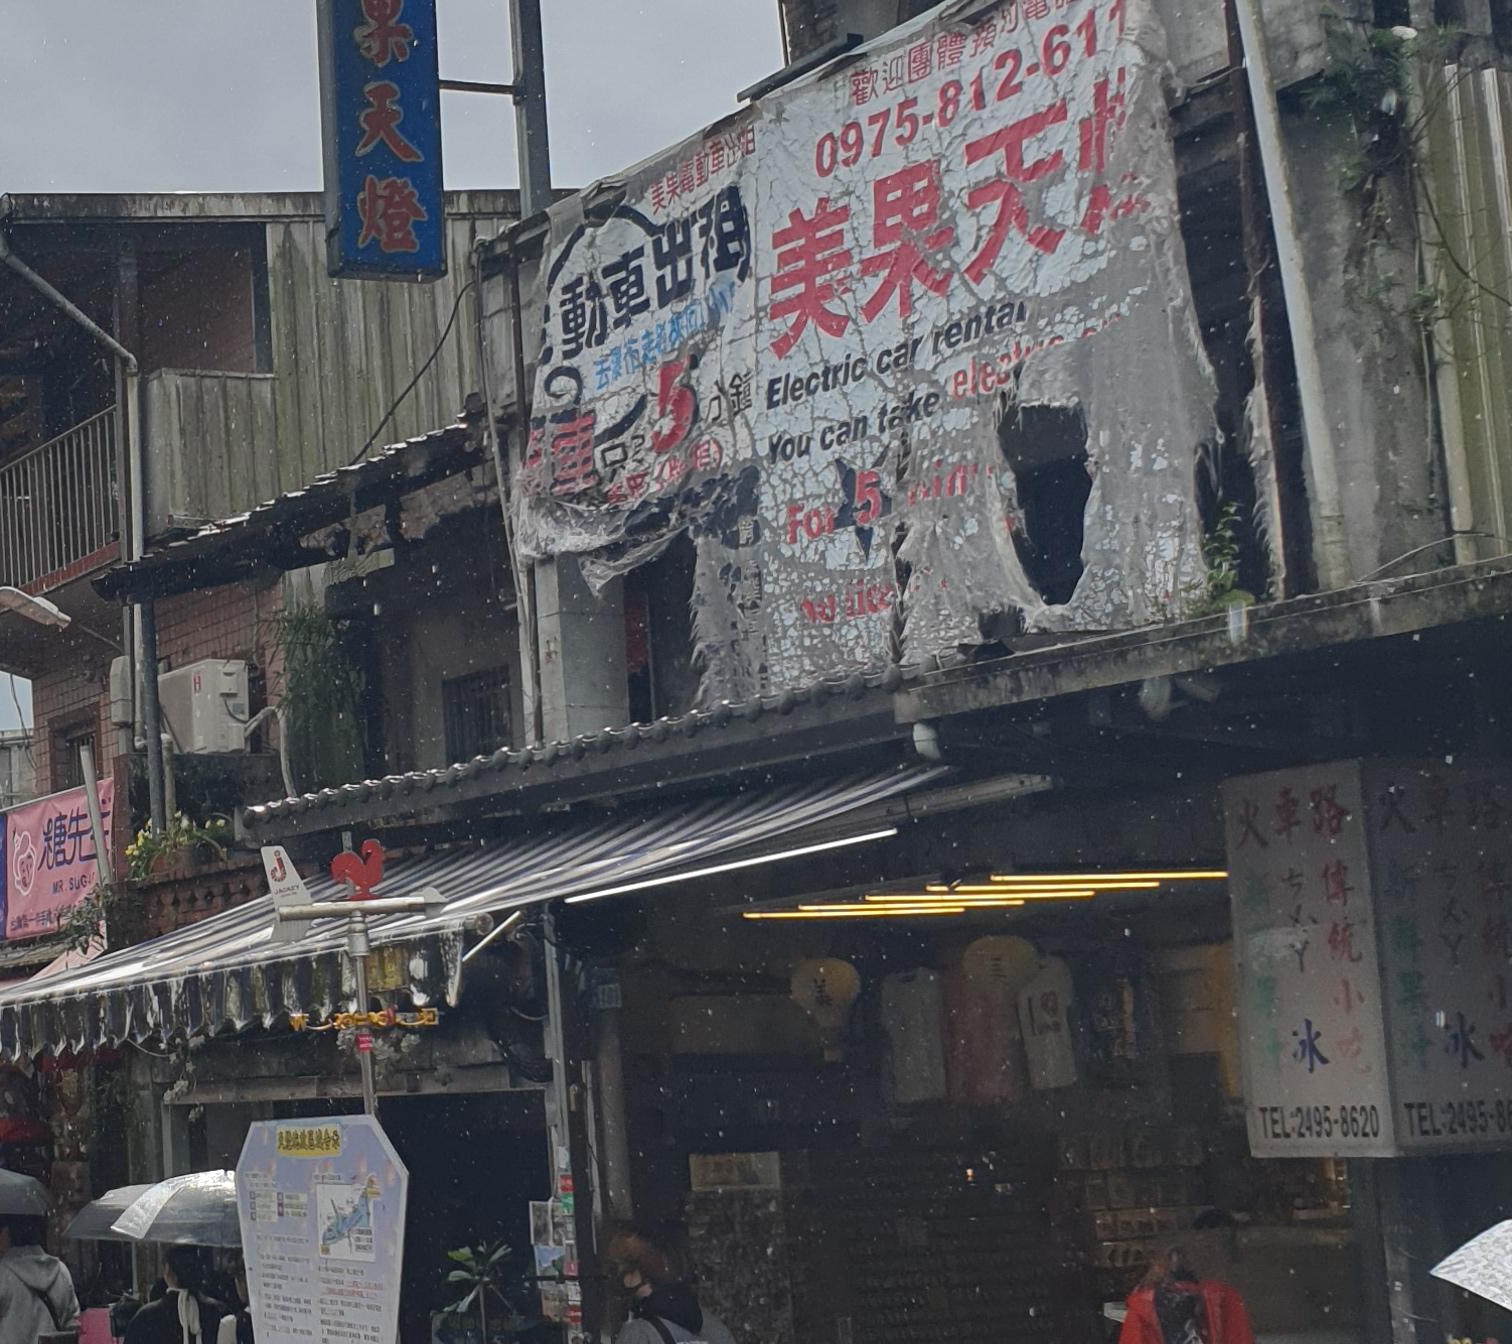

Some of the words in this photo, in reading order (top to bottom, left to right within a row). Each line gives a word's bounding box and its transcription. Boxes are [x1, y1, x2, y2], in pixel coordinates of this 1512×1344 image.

[767, 350, 867, 411] Electric
[875, 338, 919, 375] car
[767, 425, 813, 464] You
[819, 414, 868, 454] can
[854, 469, 883, 527] 5
[1258, 1104, 1380, 1140] TEL:2495-8620
